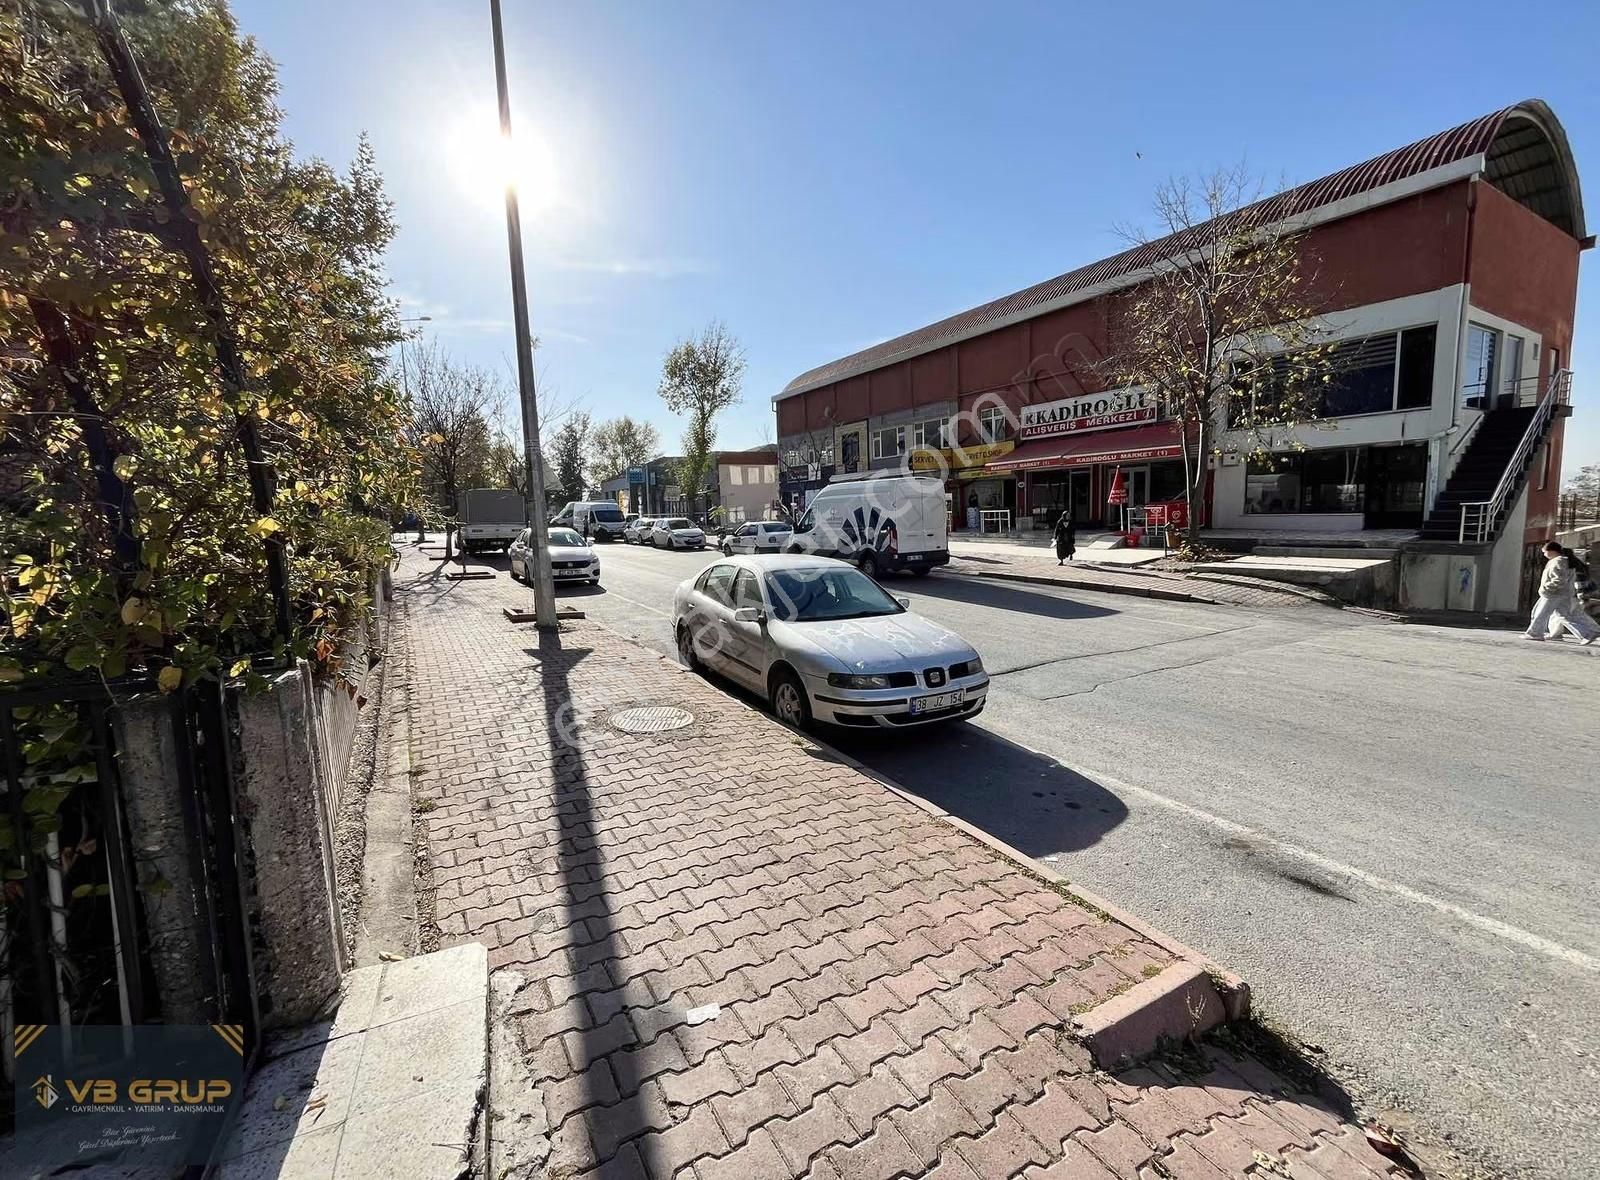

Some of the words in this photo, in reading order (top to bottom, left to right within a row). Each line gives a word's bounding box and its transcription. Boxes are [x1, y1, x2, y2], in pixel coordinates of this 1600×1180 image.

[1025, 421, 1077, 436] ALIŞVERİŞ
[1086, 411, 1137, 427] MERKEZİ
[1120, 451, 1153, 460] MARKET
[916, 698, 927, 711] 38
[933, 695, 944, 708] JZ
[950, 691, 962, 704] 154
